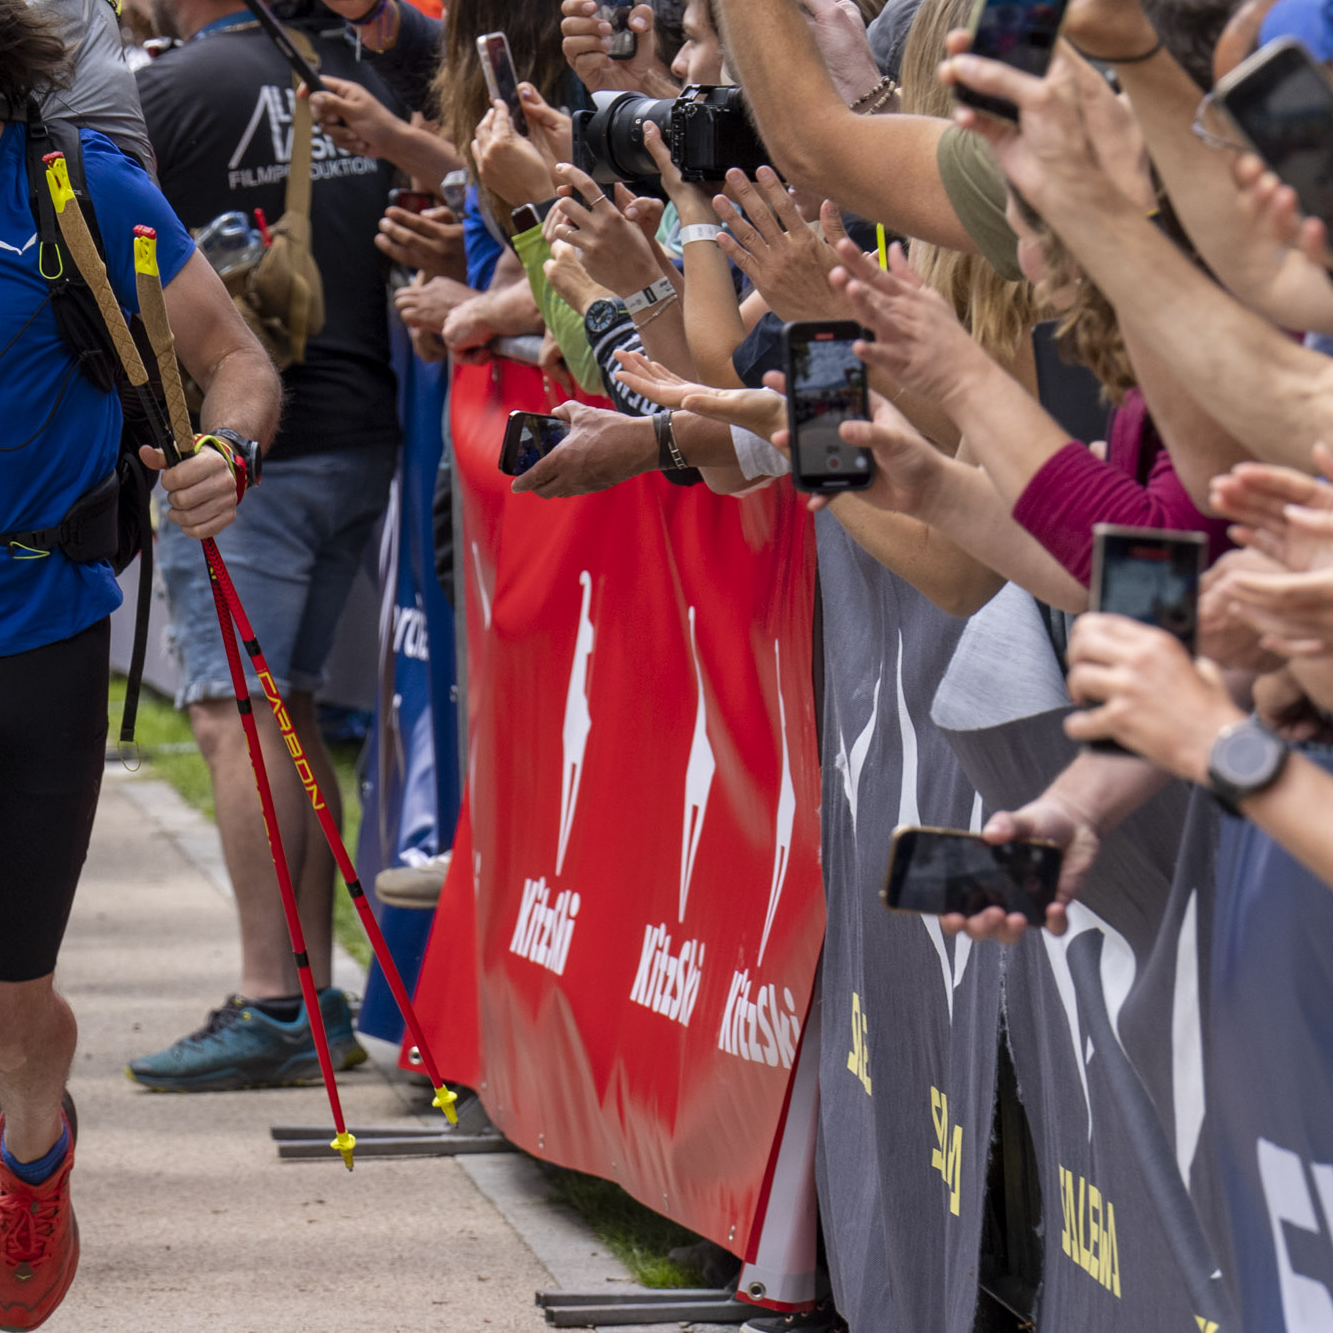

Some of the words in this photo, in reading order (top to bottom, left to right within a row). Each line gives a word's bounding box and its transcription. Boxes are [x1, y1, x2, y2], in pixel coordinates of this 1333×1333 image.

[227, 154, 379, 190] FILMPDUKTION
[257, 670, 326, 810] CARBON
[630, 923, 705, 1028] KitzSki
